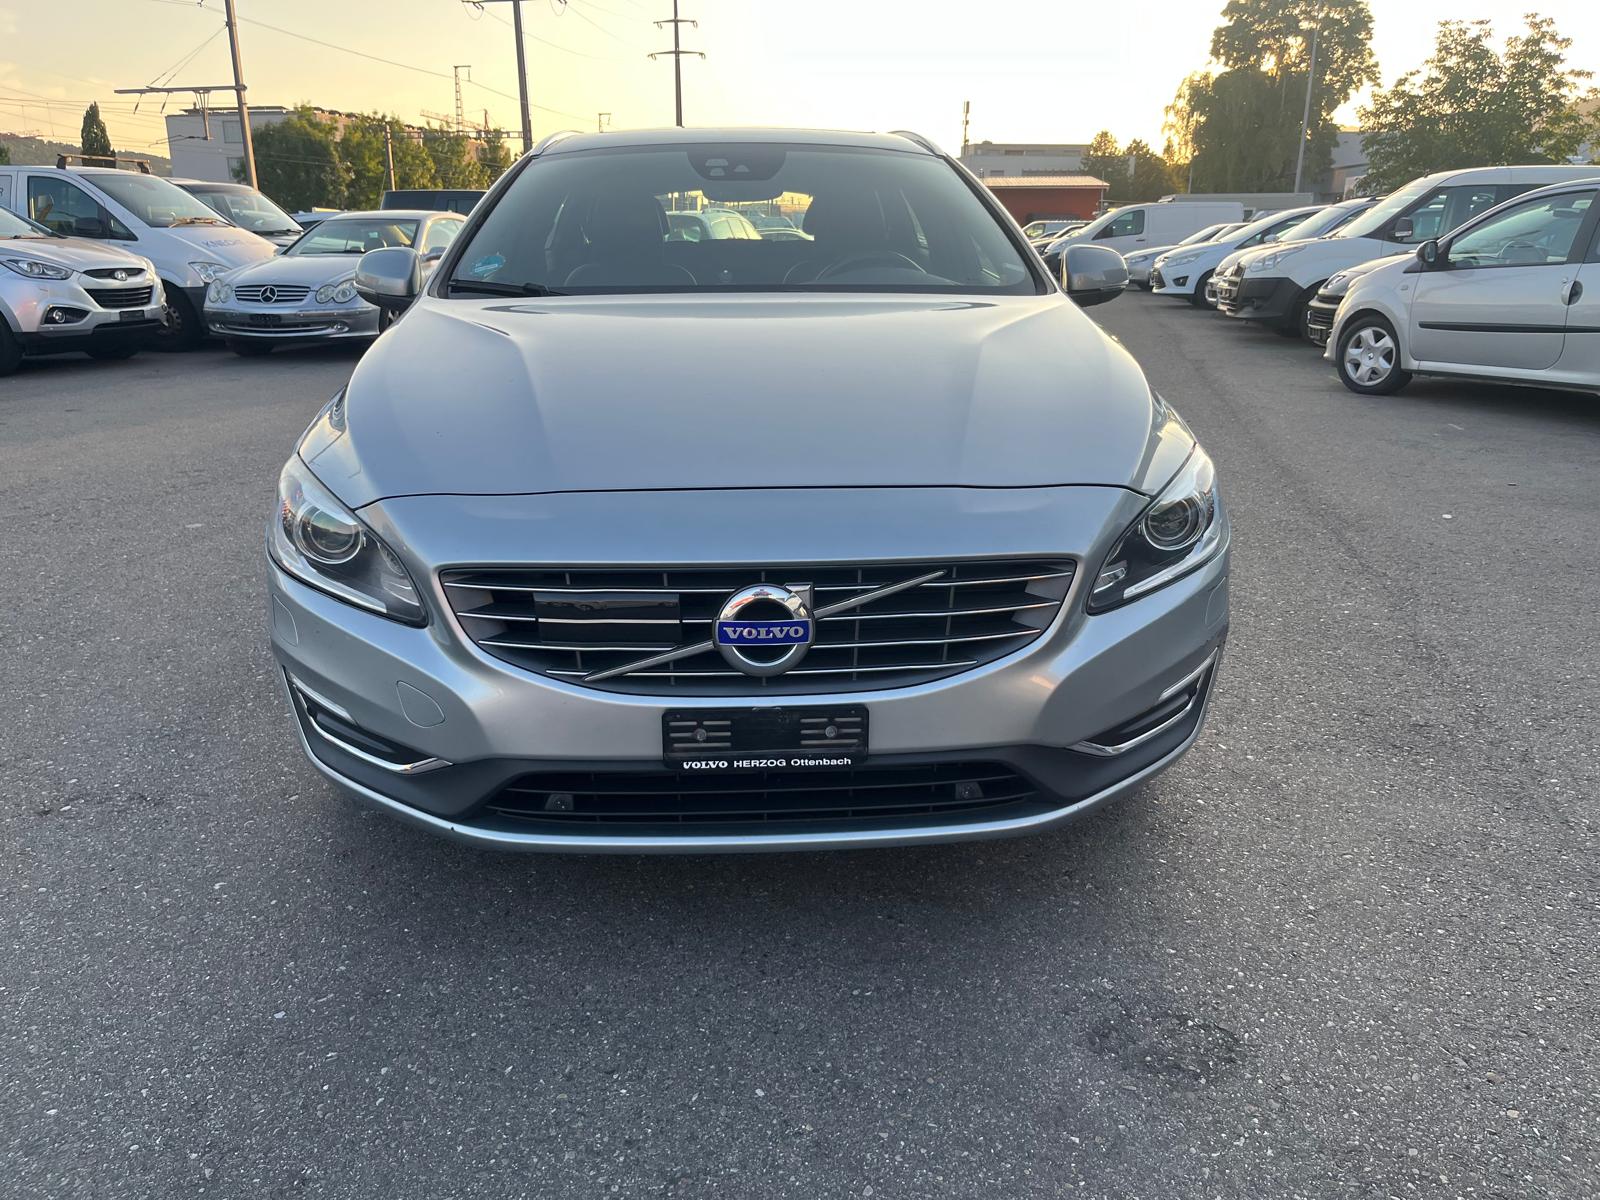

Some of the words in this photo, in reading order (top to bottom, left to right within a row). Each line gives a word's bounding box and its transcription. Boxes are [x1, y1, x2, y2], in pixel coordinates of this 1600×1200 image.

[723, 626, 804, 639] VOLVO
[683, 760, 728, 770] VOLVO
[733, 758, 787, 768] HERZOG
[790, 757, 852, 767] Ottenbach
